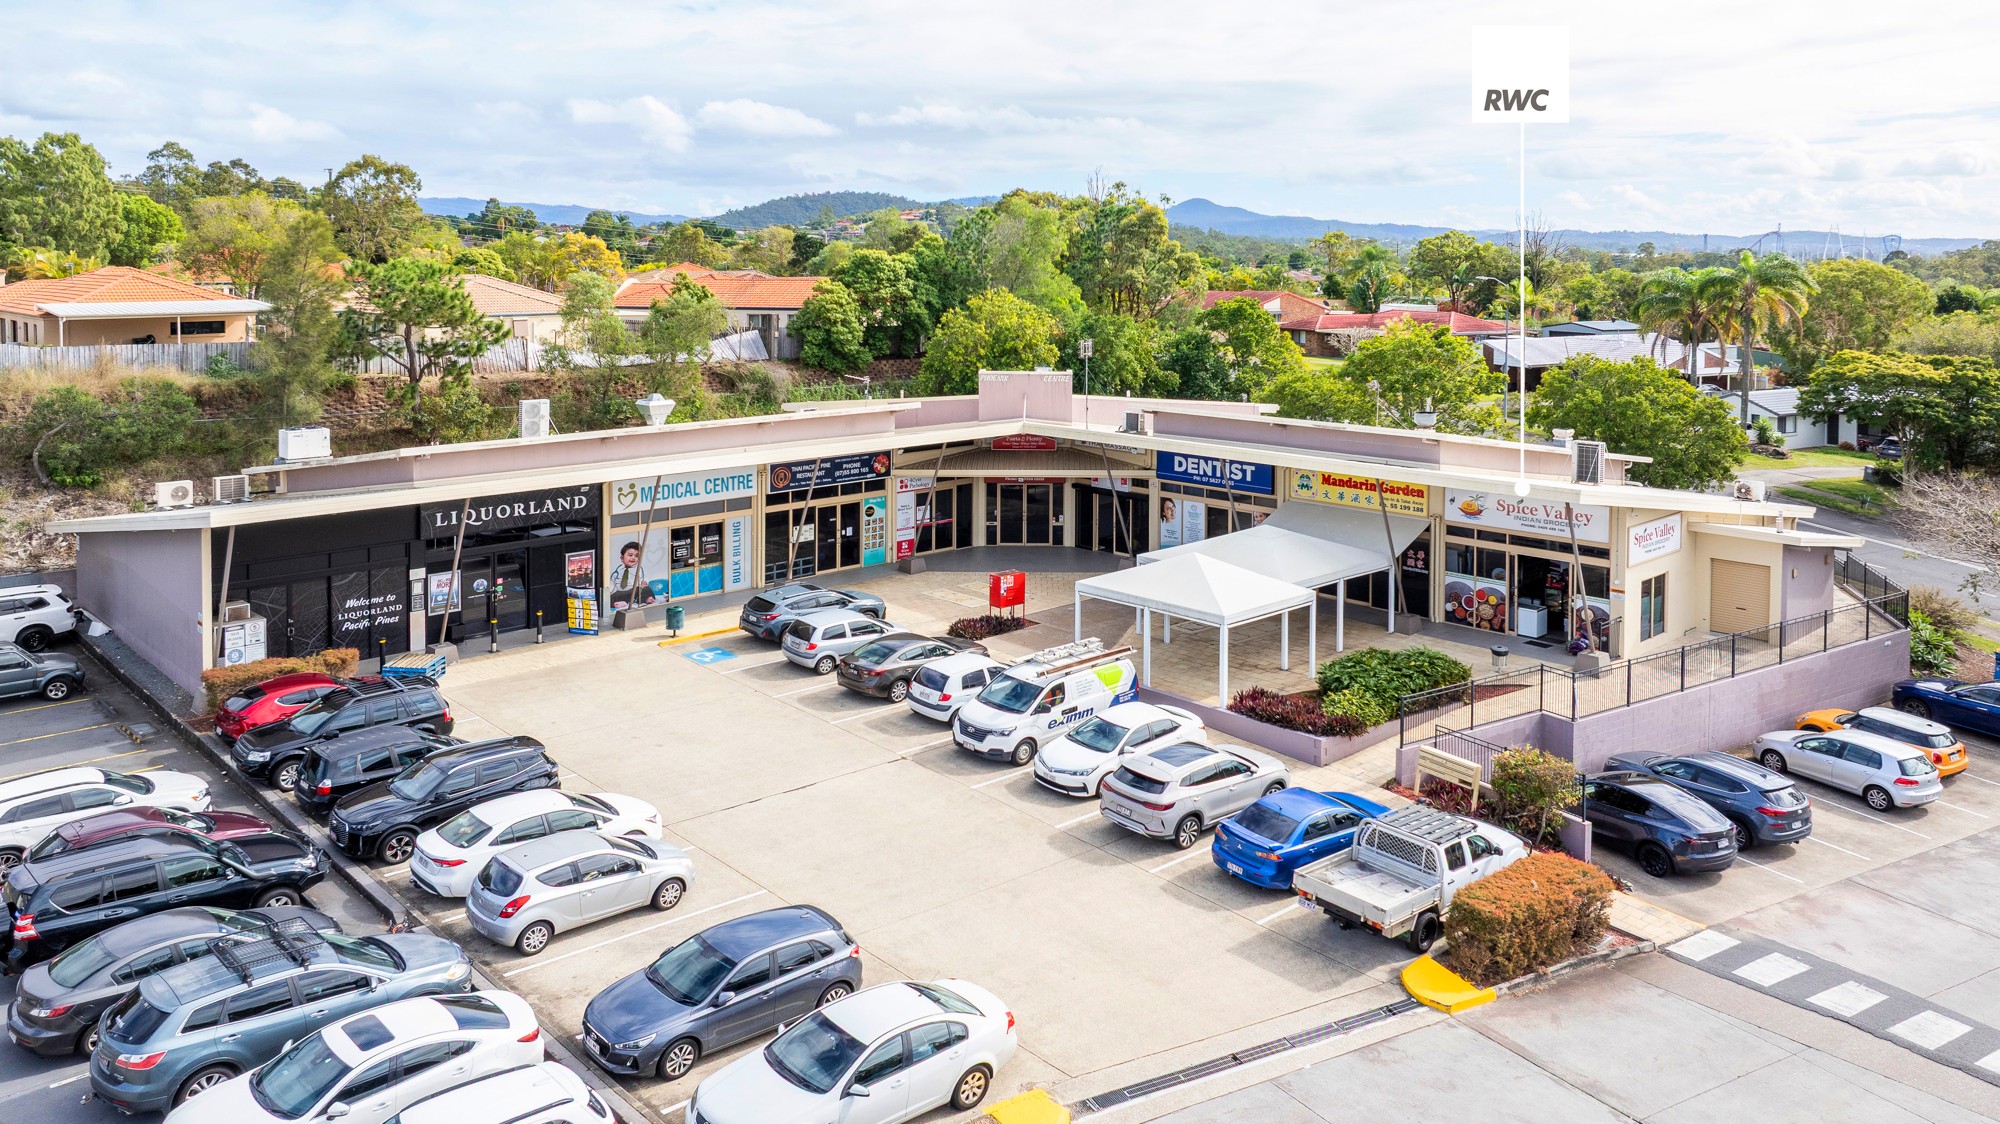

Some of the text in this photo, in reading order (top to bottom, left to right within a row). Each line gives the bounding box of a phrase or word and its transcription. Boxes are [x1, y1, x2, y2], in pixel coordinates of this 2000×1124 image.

[640, 474, 753, 503] MEDICAL CENTRE
[1321, 473, 1425, 499] Mandarin Garden
[435, 495, 587, 527] LIQUORLAND
[1496, 498, 1538, 516] Spice
[1513, 515, 1541, 523] INDIAN
[1634, 523, 1676, 547] Spice Valley
[732, 521, 741, 584] BULK BILLING
[386, 594, 396, 602] to
[338, 604, 403, 620] LIQUORLAND
[375, 616, 400, 626] Pines
[1048, 707, 1094, 730] eximm
